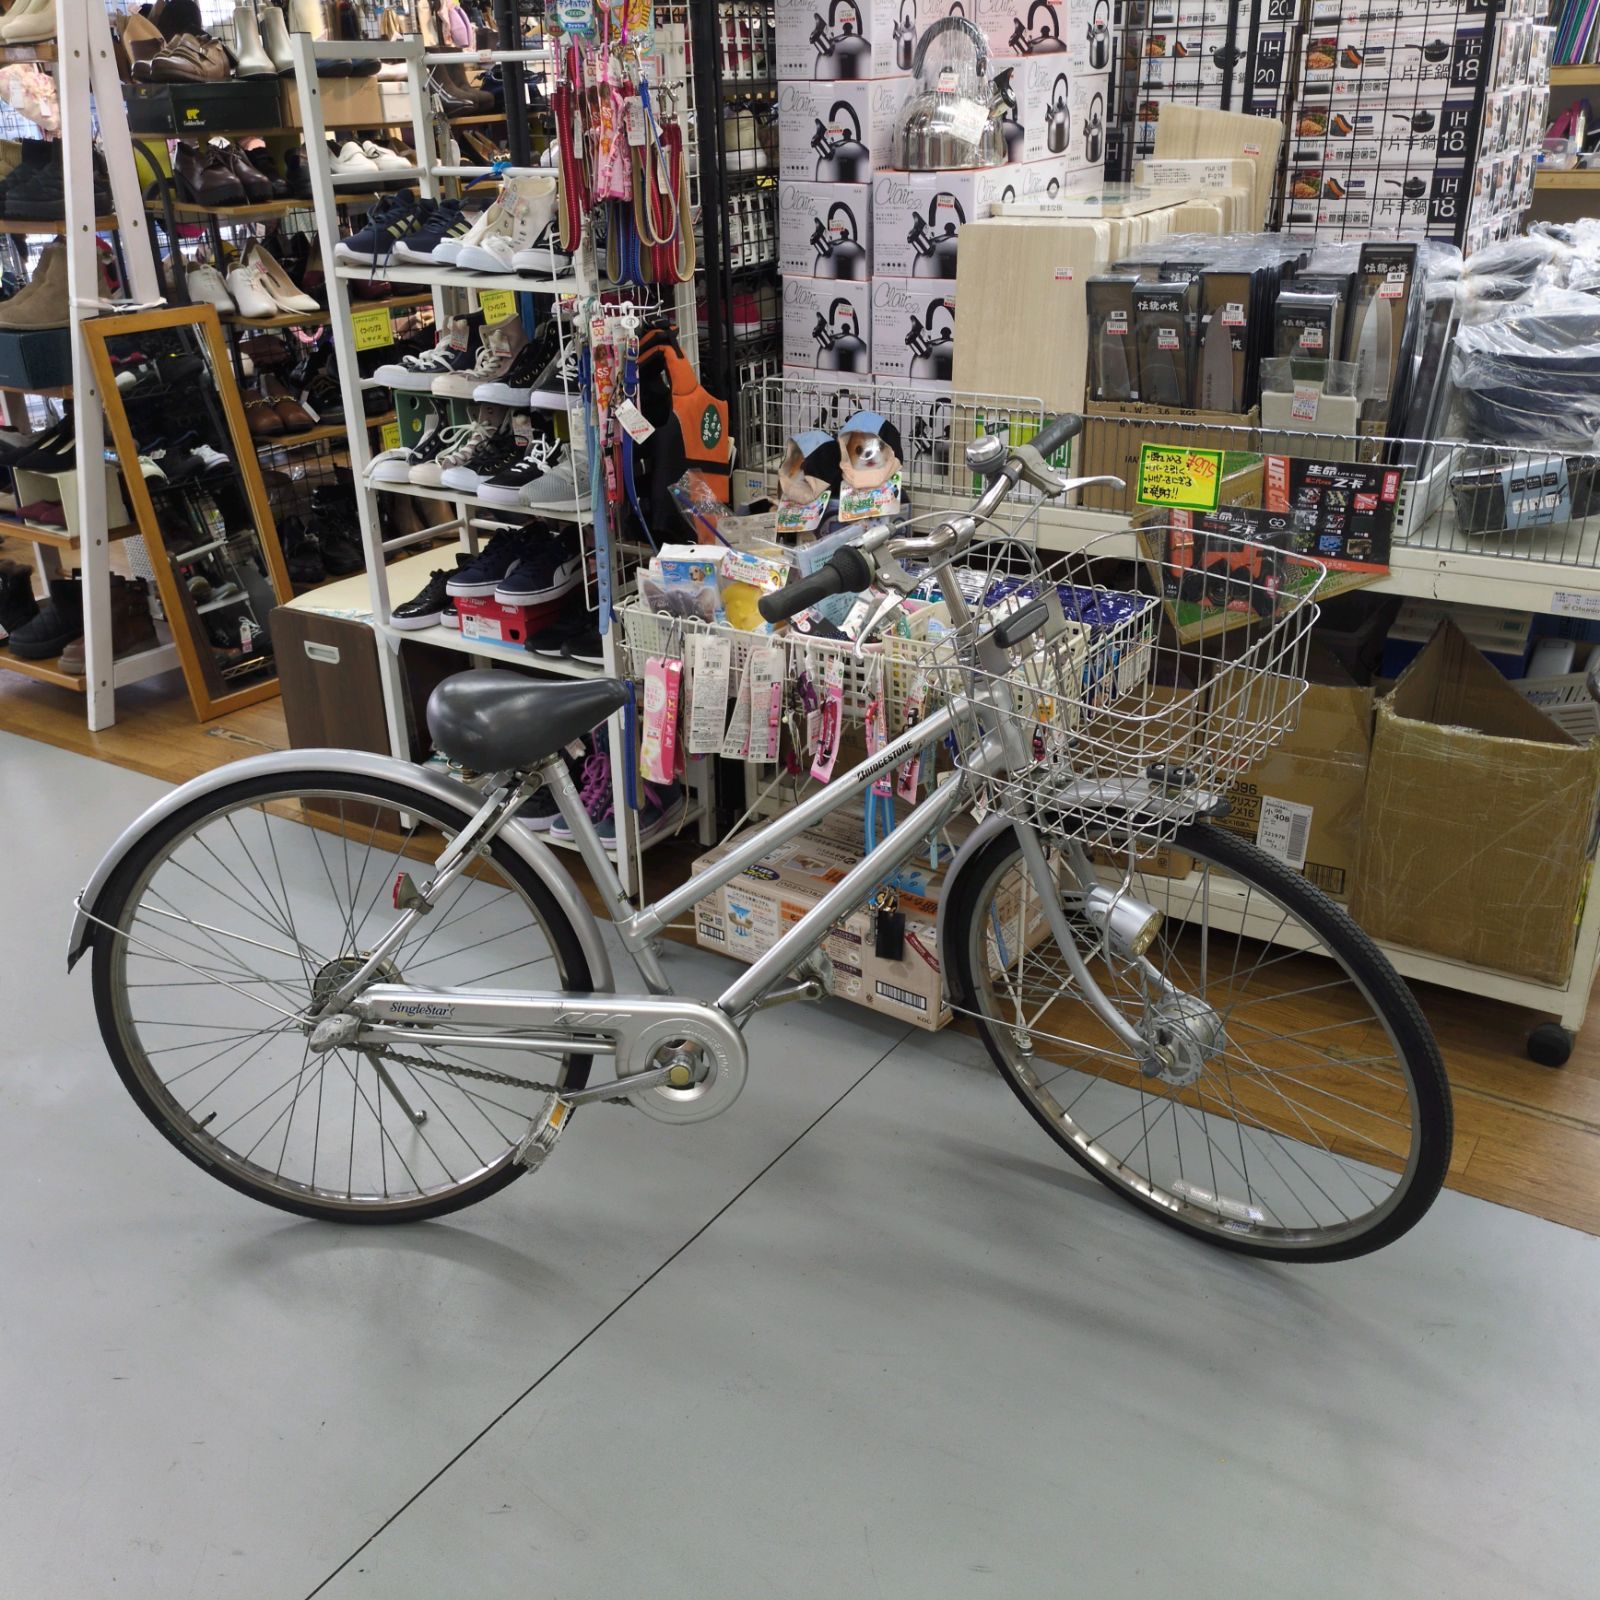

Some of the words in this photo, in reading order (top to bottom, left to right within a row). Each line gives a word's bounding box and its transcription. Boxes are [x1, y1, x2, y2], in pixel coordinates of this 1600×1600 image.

[1257, 69, 1275, 83] 20
[1403, 63, 1449, 82] 片手鍋
[1456, 59, 1479, 81] 18
[1451, 111, 1467, 127] IH
[1388, 135, 1436, 151] 片手鍋
[1442, 131, 1465, 151] 18
[875, 178, 914, 206] Clair
[1441, 178, 1459, 194] IH
[1380, 200, 1427, 216] 片手鍋
[1432, 197, 1455, 217] 18
[1170, 272, 1199, 283] 伝統の
[874, 282, 912, 308] Clair
[1138, 301, 1180, 312] 伝統の技
[856, 740, 913, 783] BRIDGESTONE
[389, 1002, 450, 1017] SingleStar
